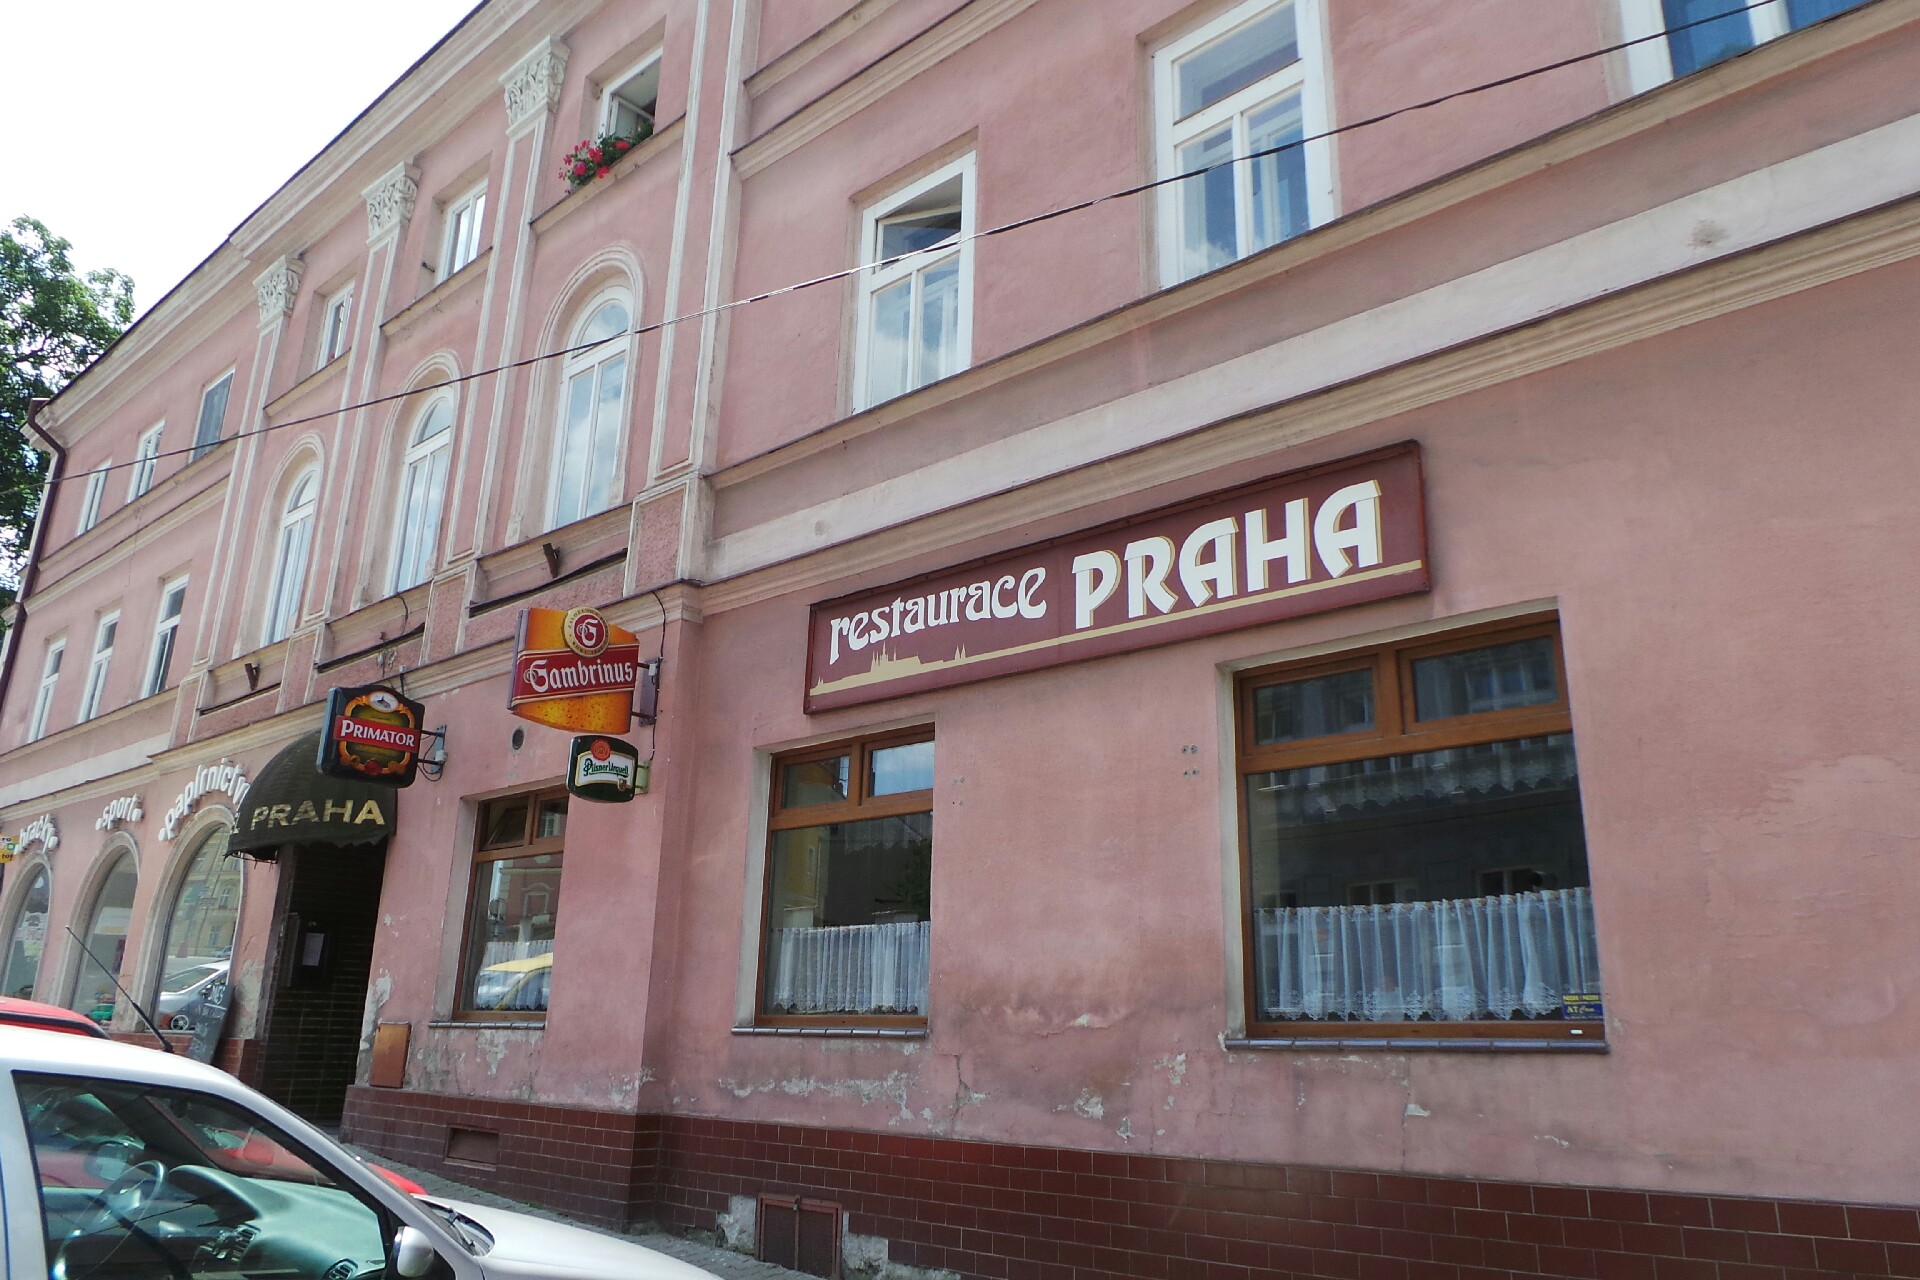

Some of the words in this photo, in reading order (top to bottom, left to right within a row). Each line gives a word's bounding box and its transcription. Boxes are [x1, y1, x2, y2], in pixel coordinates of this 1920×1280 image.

[829, 566, 1047, 665] restaurace
[1071, 479, 1383, 630] PRAHA
[523, 659, 633, 692] Gambrinus
[341, 719, 415, 747] PRIMATOR
[583, 757, 609, 777] Pilsner
[608, 760, 629, 775] Urquell
[250, 799, 385, 831] PRAHA
